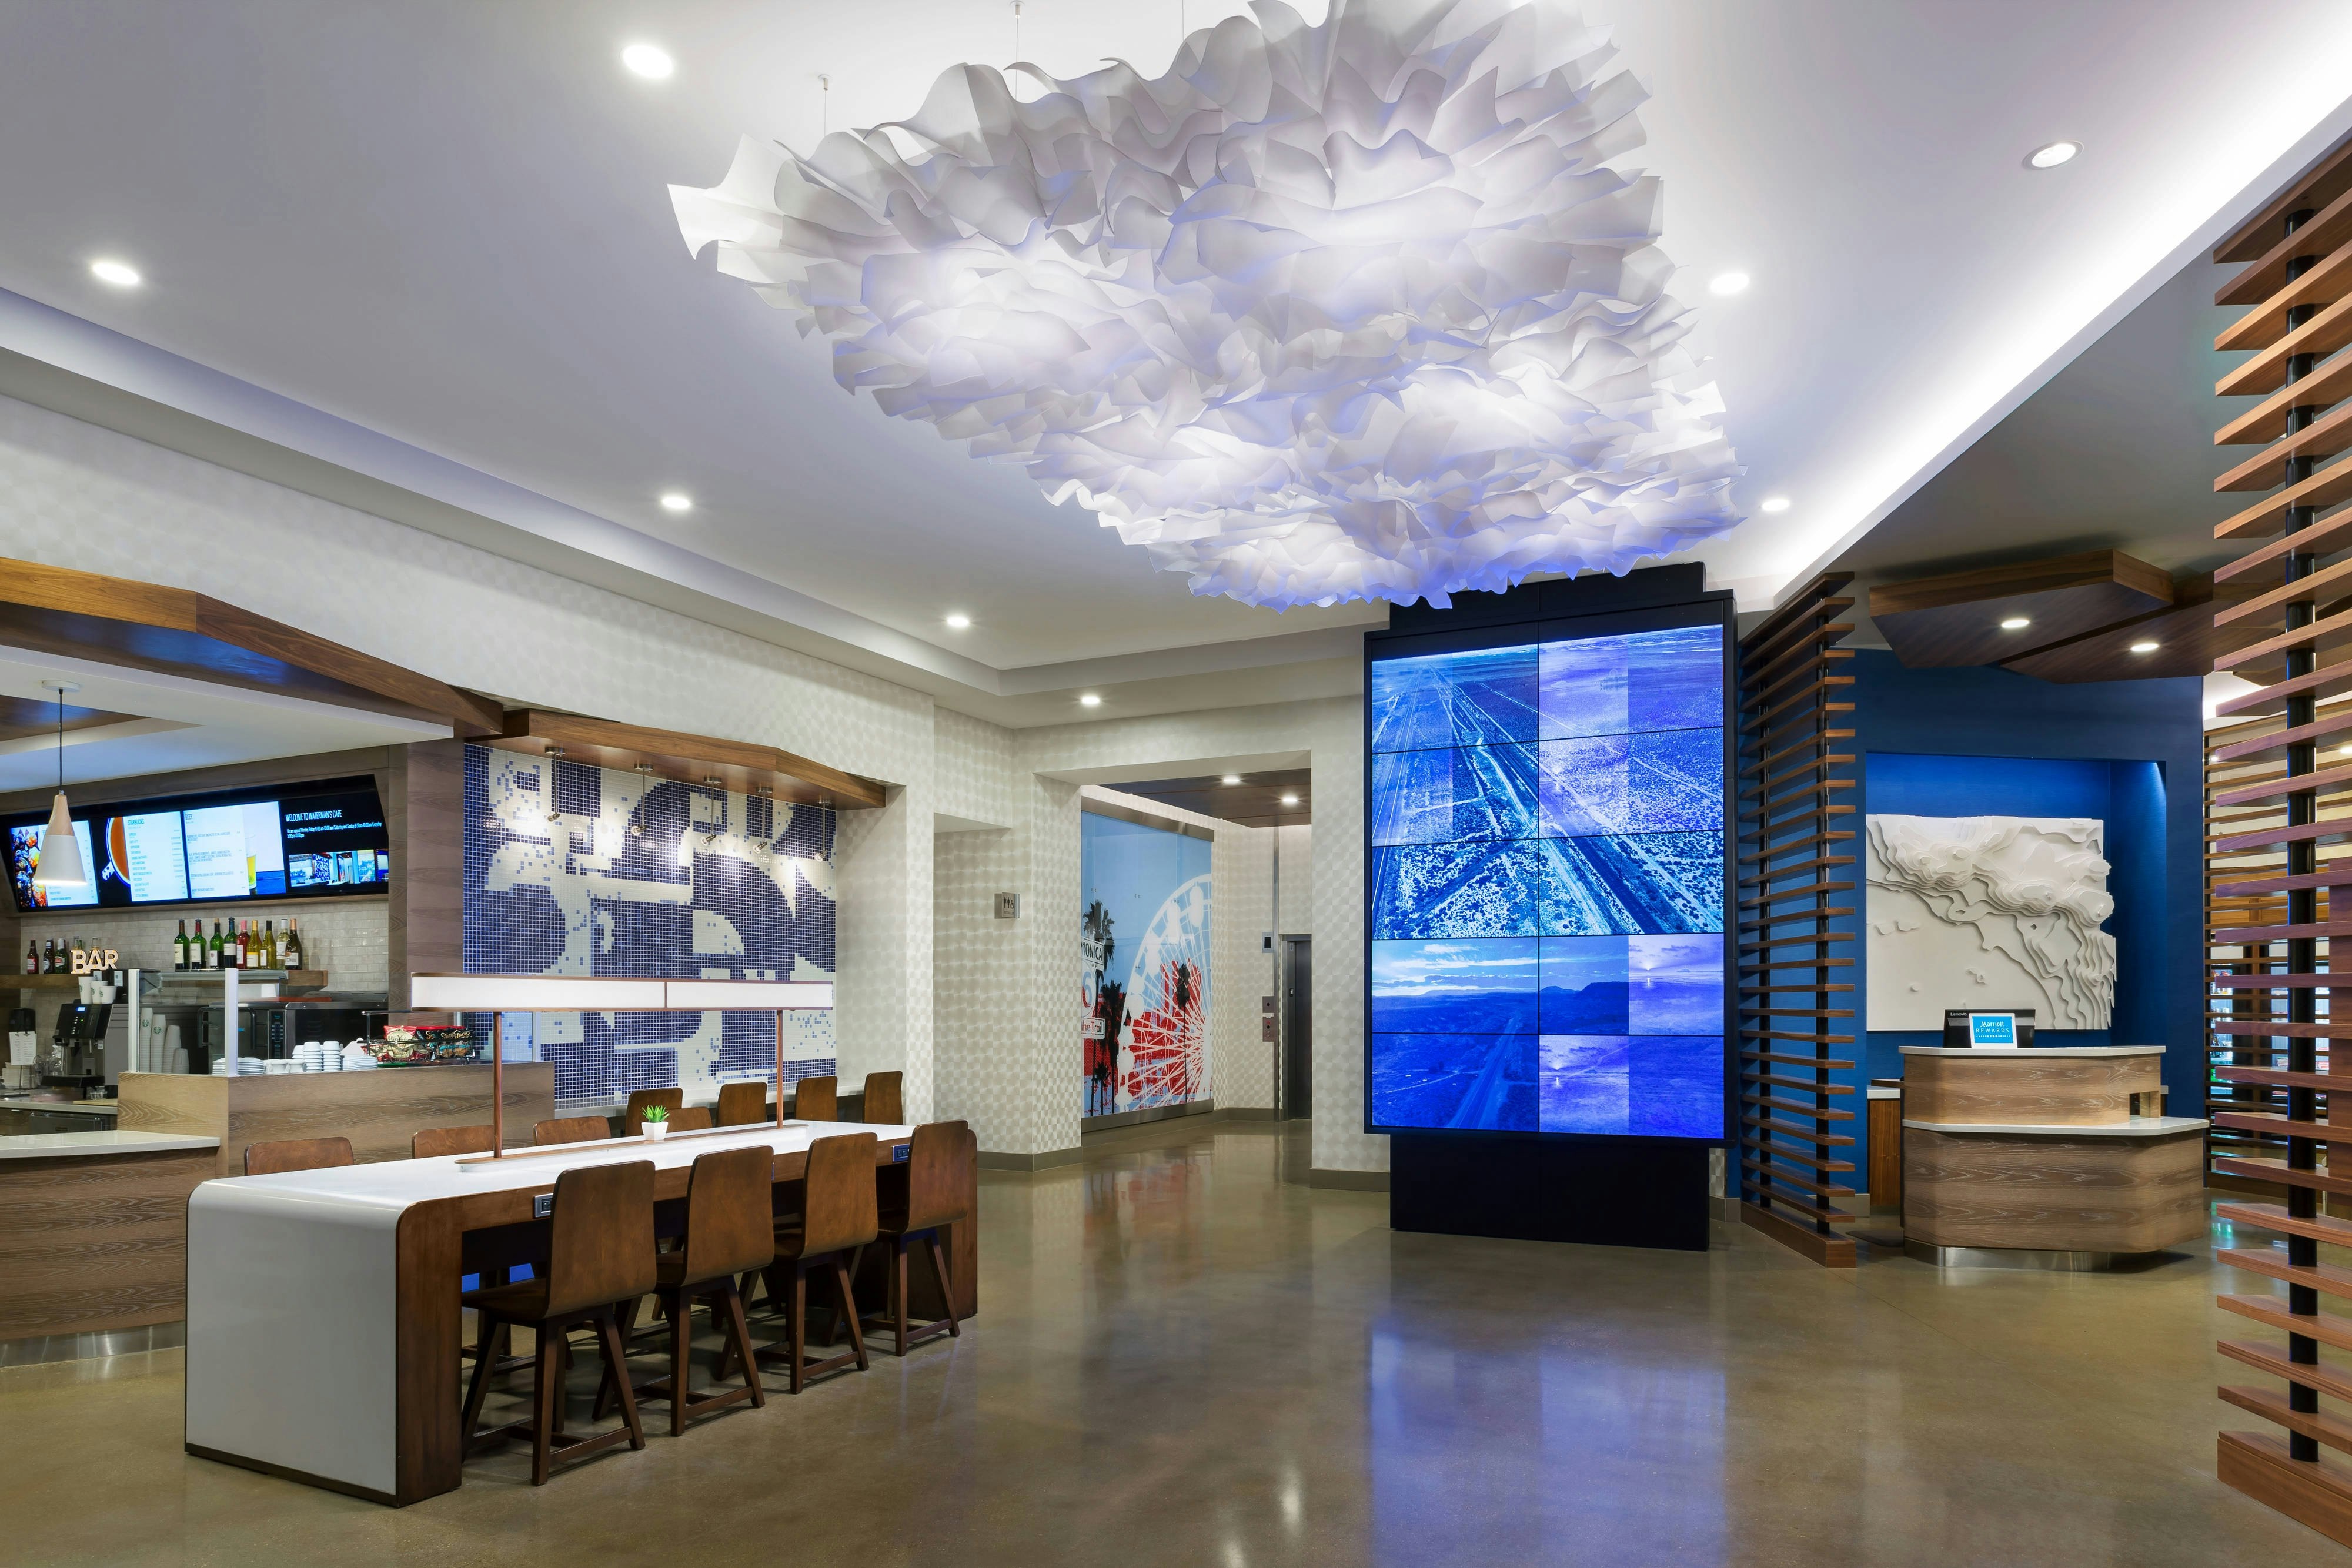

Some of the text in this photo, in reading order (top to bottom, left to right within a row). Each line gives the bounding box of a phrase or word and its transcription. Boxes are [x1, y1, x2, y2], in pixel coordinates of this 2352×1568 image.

[285, 813, 303, 822] WELCOME
[309, 810, 332, 820] WATERMAN'S
[332, 810, 342, 818] CAFE
[70, 949, 119, 974] BAR
[1091, 1021, 1103, 1033] Trail
